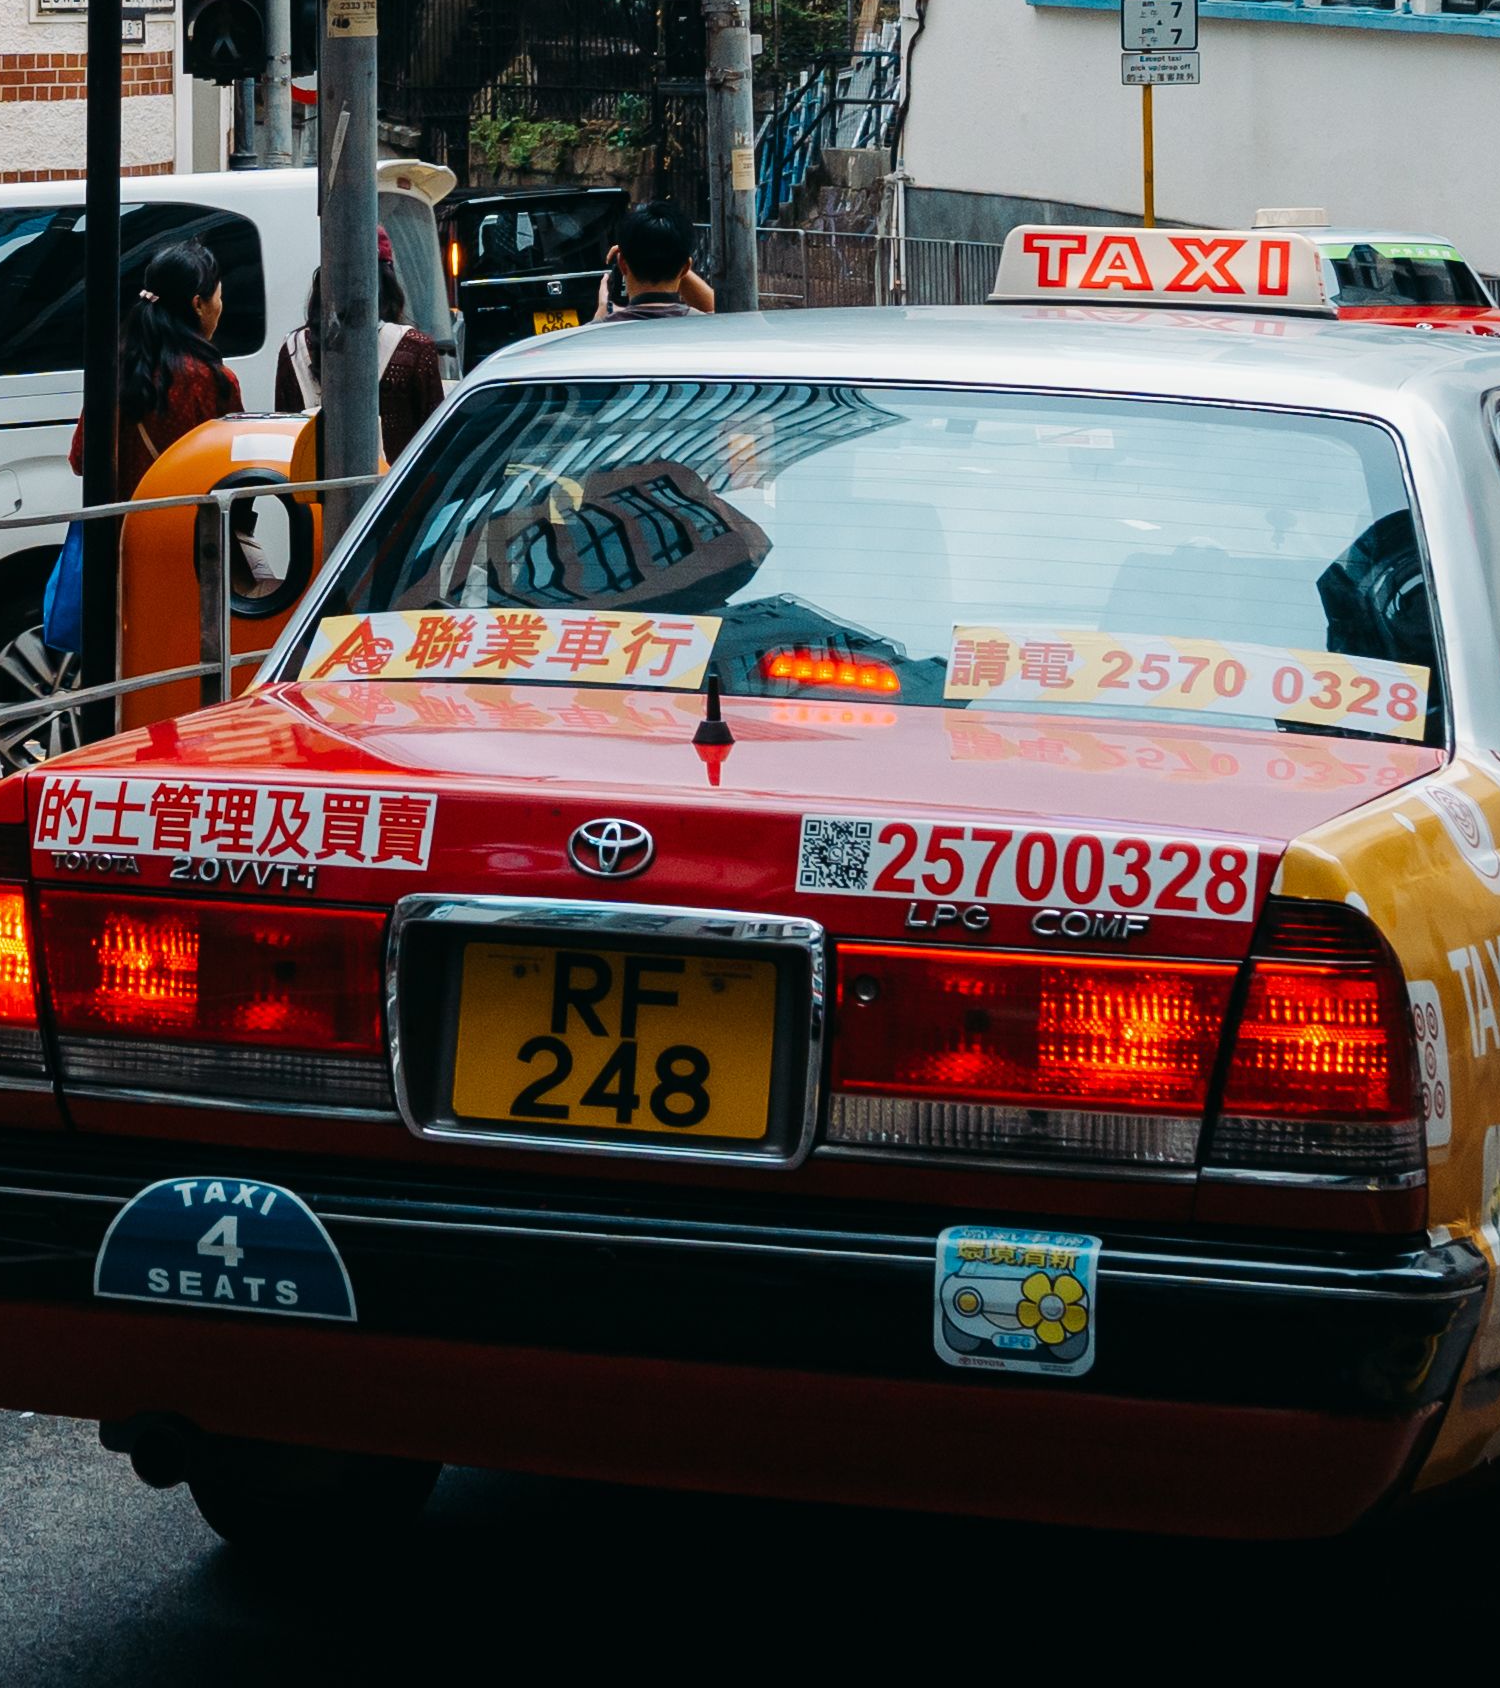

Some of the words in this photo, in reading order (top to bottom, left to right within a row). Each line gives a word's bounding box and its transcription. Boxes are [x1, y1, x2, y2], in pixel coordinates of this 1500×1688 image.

[1170, 1, 1182, 18] 7
[1170, 28, 1182, 45] 7
[1024, 232, 1290, 296] TAXI
[405, 614, 695, 677] 聯業車行
[950, 639, 1075, 689] 請電
[1097, 650, 1246, 698] 2570
[1272, 666, 1419, 722] 0328
[38, 779, 432, 866] 的士管理及買賣
[51, 852, 139, 874] TOYOTA
[873, 822, 1248, 915] 25700328
[905, 902, 990, 930] LPG
[1031, 909, 1150, 939] COMF
[550, 951, 687, 1038] RF
[510, 1034, 711, 1128] 248
[174, 1180, 278, 1217] TAXI
[197, 1215, 244, 1267] 4
[147, 1267, 300, 1306] SEATS
